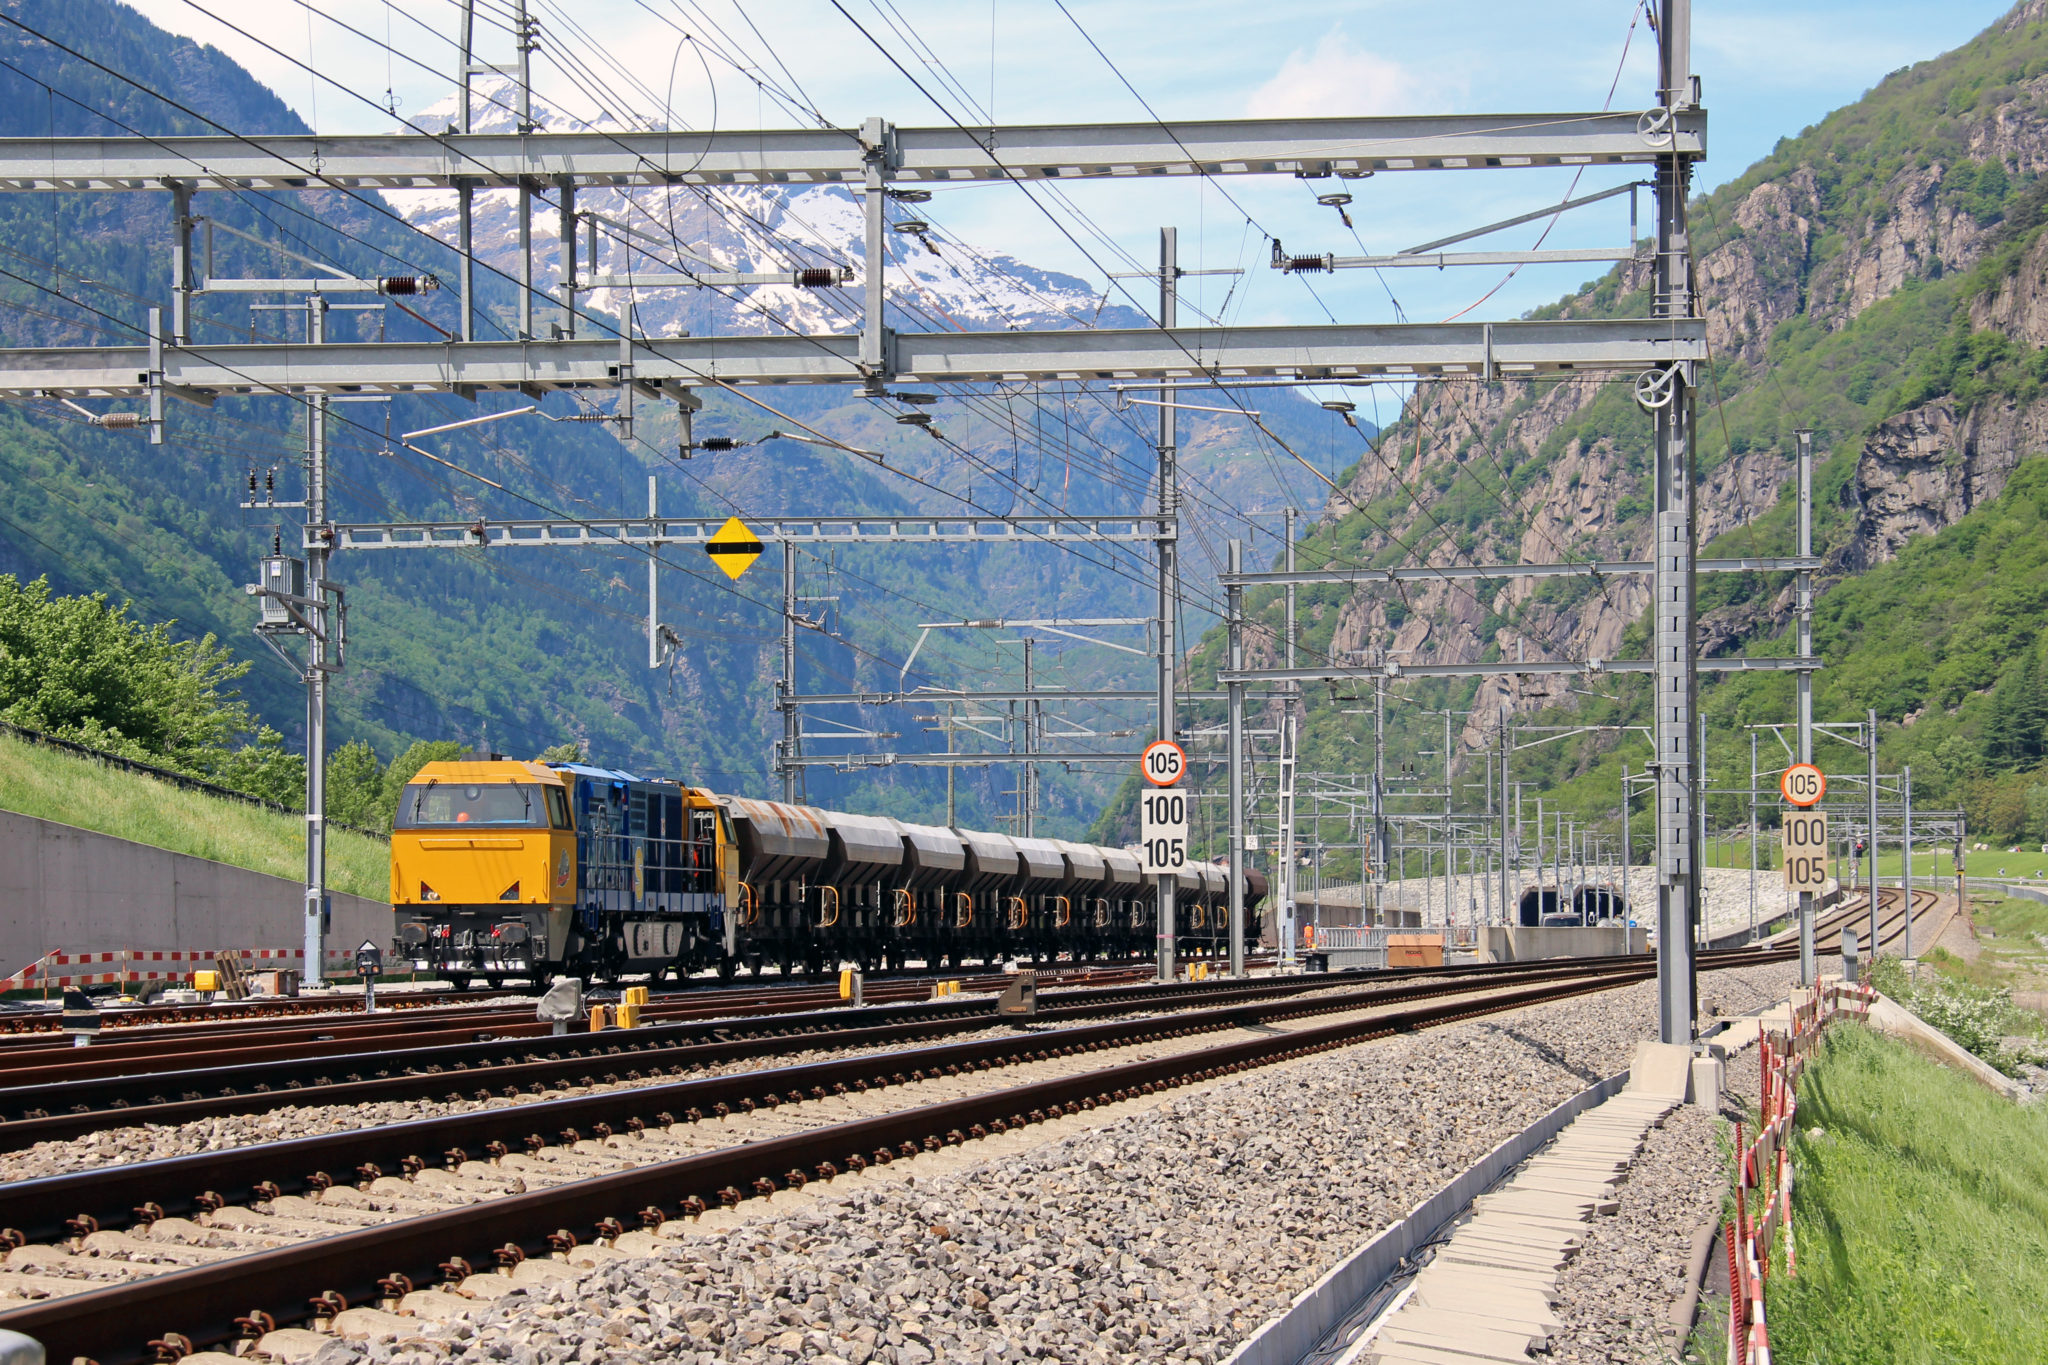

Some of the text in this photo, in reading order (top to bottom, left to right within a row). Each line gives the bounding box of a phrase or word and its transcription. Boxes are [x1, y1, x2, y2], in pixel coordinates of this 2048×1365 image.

[1148, 752, 1178, 774] 105
[1789, 774, 1817, 795] 105
[1144, 796, 1184, 825] 100
[1784, 819, 1824, 846] 100
[1144, 838, 1184, 867] 105
[1786, 857, 1825, 884] 105
